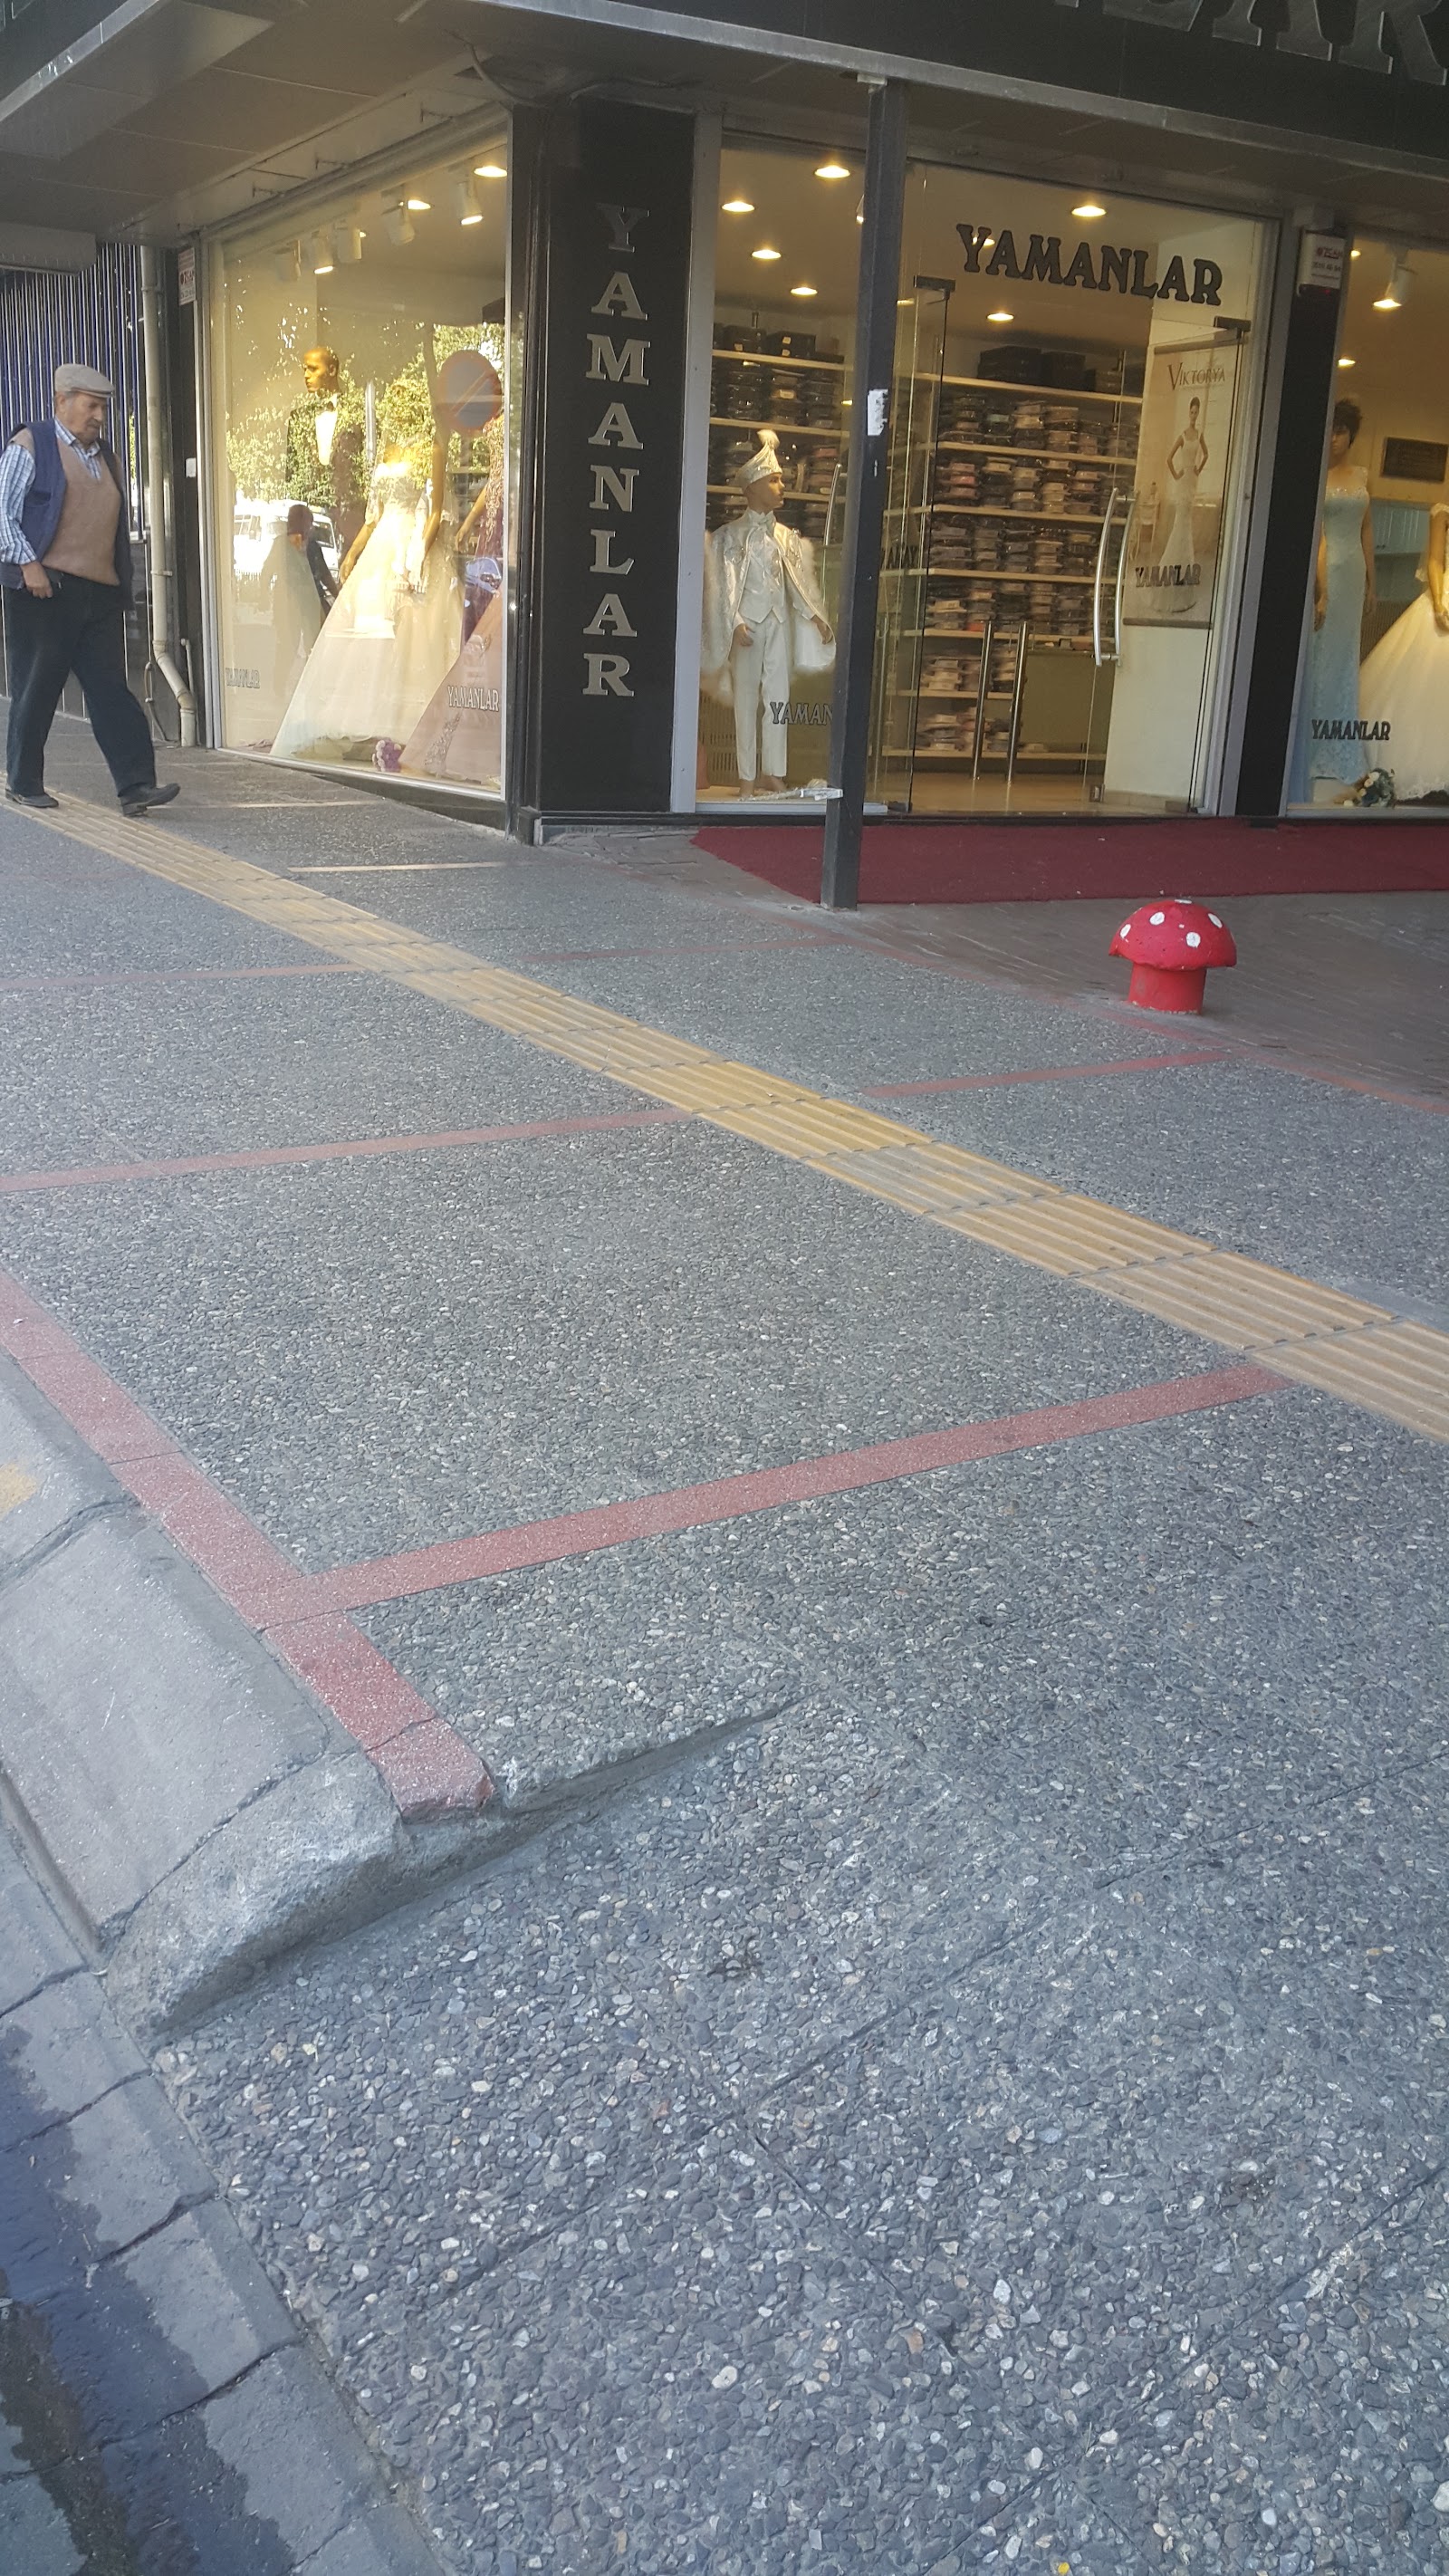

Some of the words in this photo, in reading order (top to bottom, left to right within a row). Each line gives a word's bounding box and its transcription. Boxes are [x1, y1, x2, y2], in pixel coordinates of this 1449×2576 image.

[956, 223, 1223, 306] YAMANLAR
[1167, 362, 1225, 390] VIKTORYA
[582, 202, 650, 697] YAMANLAR
[1135, 563, 1201, 587] YAMANLAR
[447, 685, 499, 712] YAMANLAR
[769, 701, 832, 726] YAMAN
[1311, 719, 1391, 740] YAMANLAR
